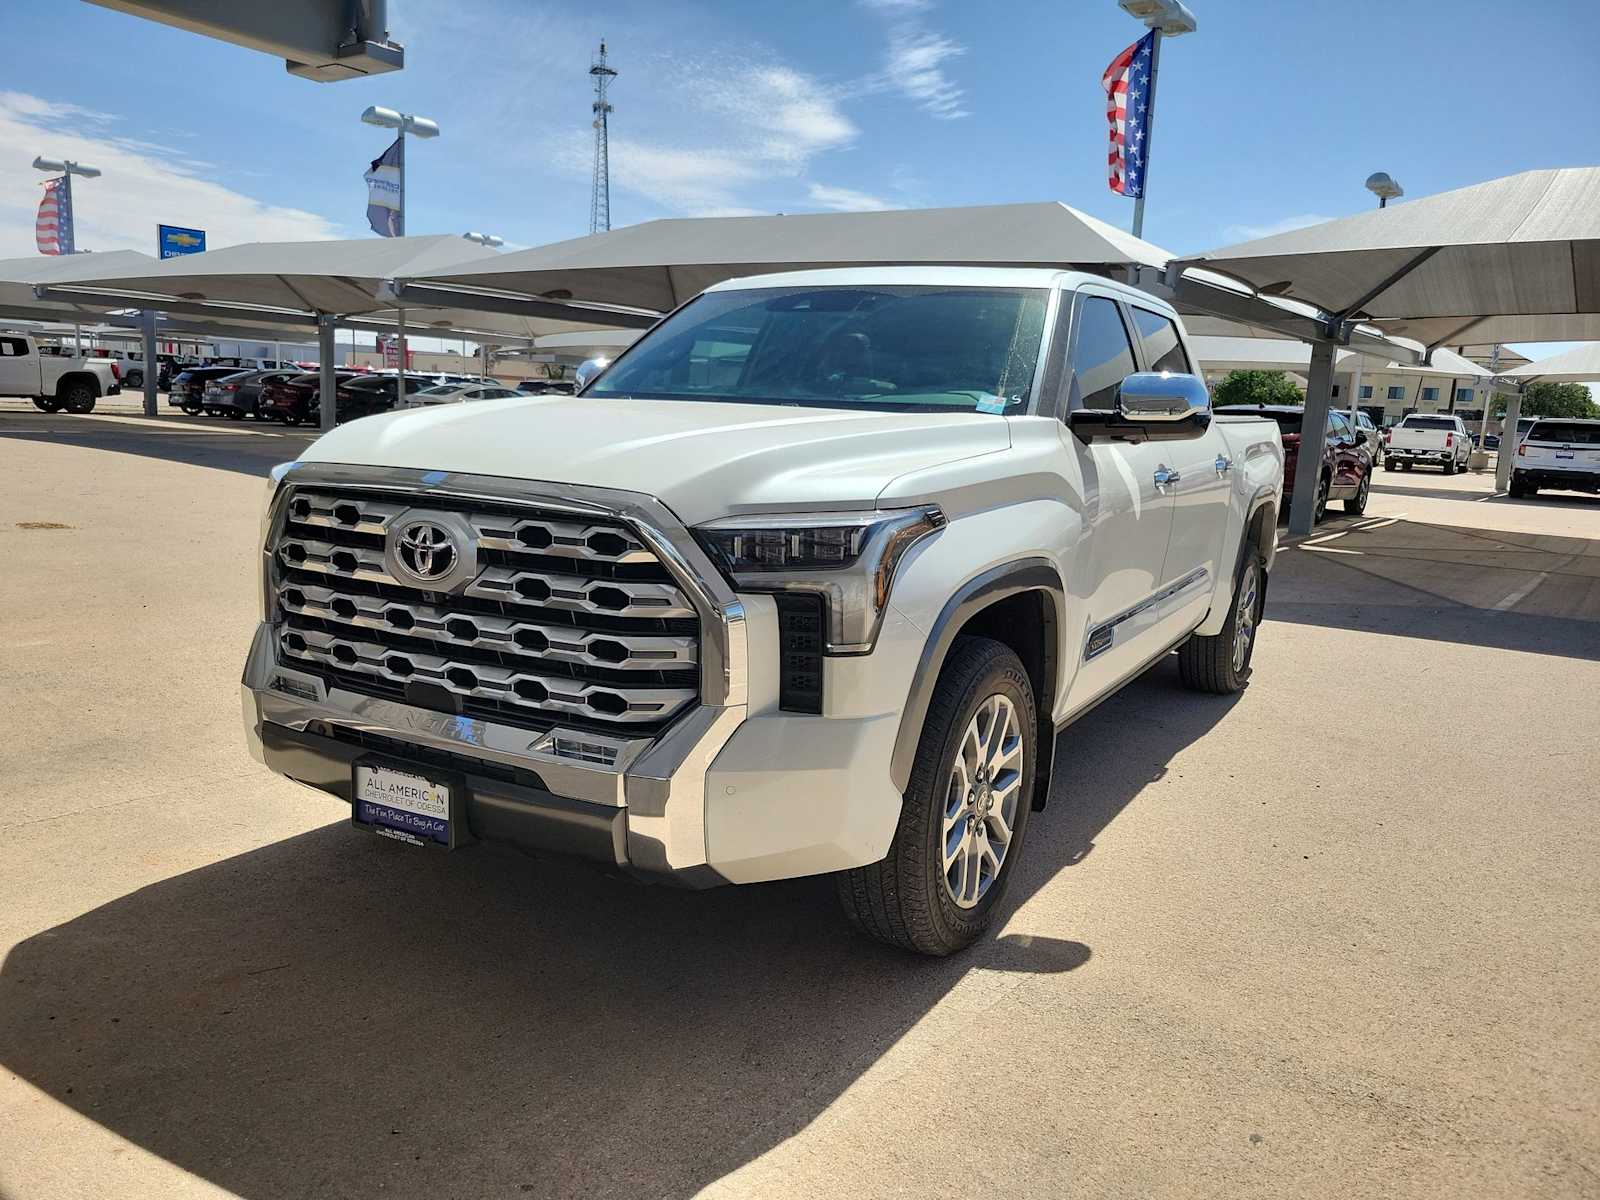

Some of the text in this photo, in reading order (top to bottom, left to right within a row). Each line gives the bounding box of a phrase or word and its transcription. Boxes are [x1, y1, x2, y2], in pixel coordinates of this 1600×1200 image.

[367, 777, 386, 792] ALL
[364, 788, 446, 815] CHEVROLET OF ODESSA
[365, 804, 376, 816] The
[387, 809, 405, 822] Place
[403, 813, 413, 824] To
[413, 817, 426, 830] Buy
[425, 820, 433, 829] A
[433, 821, 445, 832] Car
